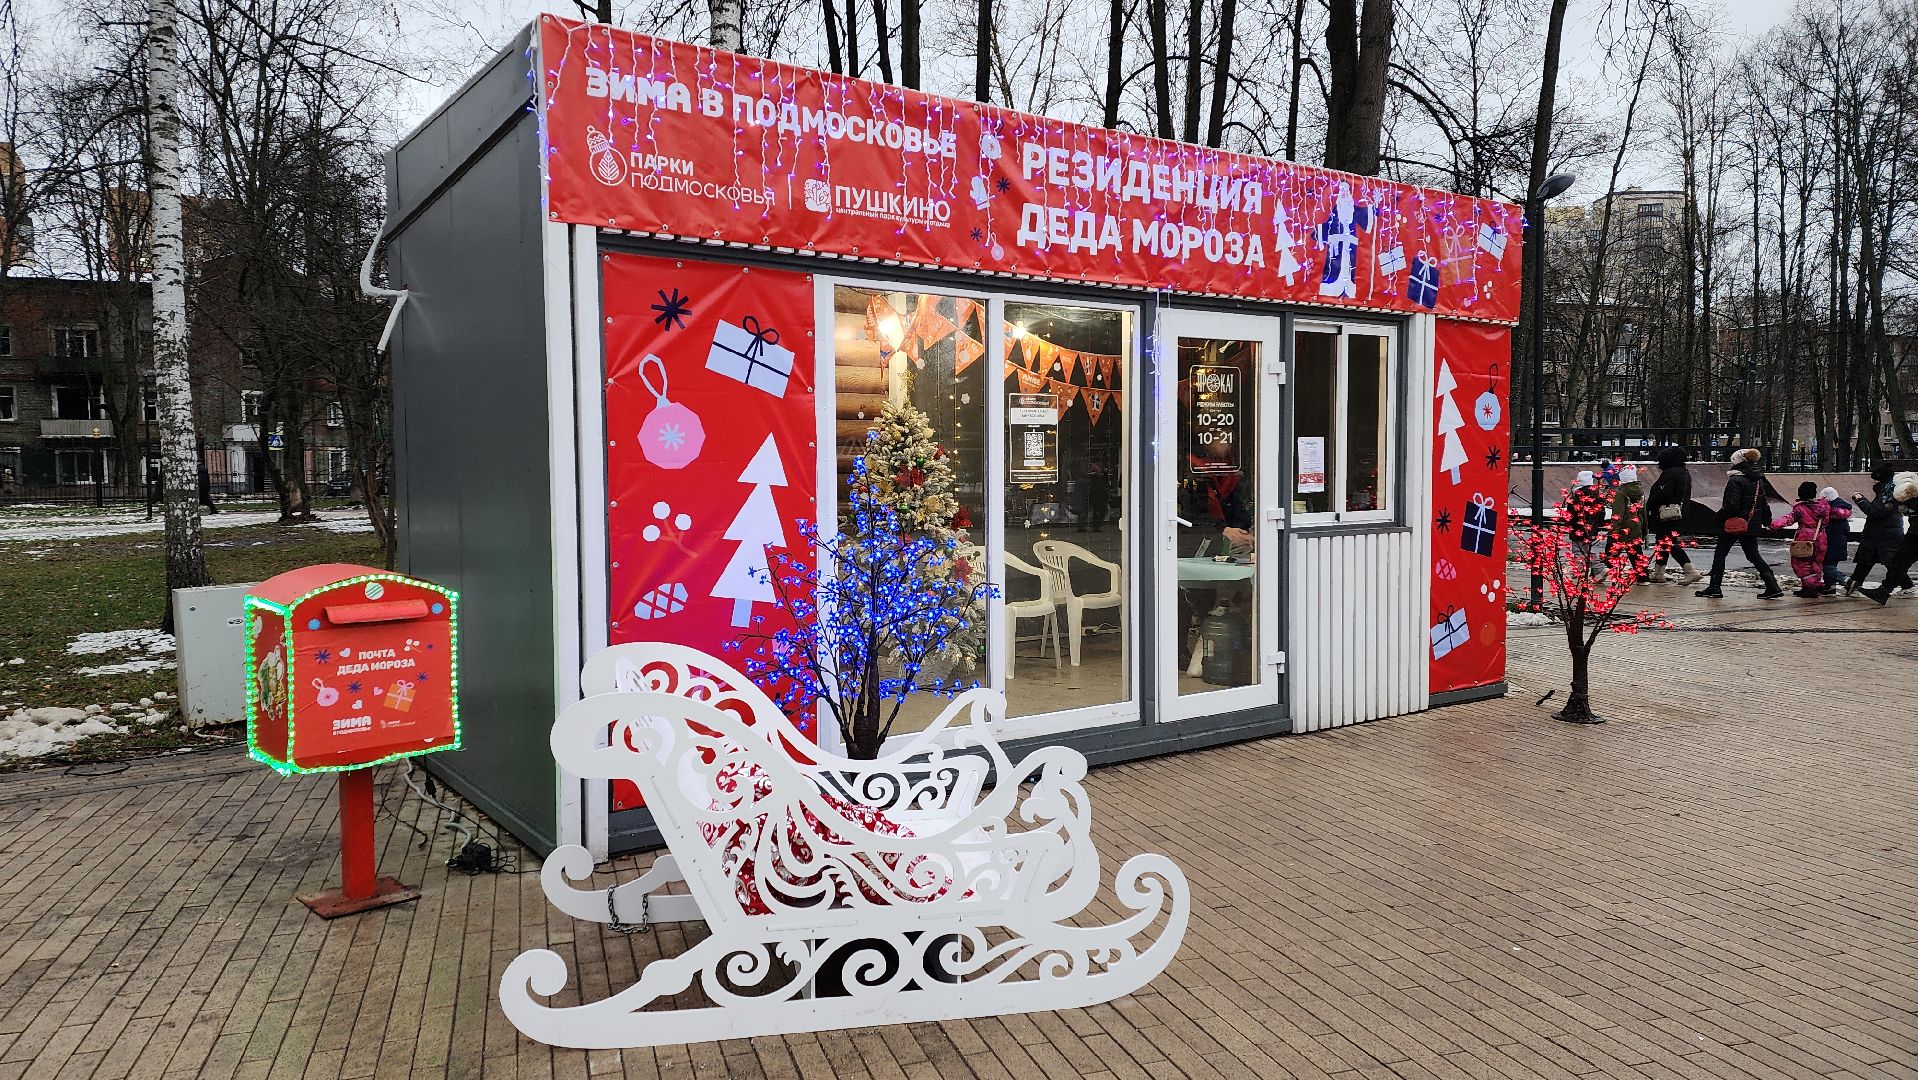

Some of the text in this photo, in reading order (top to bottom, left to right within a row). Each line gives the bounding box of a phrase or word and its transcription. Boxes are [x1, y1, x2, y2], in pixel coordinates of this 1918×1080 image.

[585, 67, 957, 159] ЗИМА В ПОДМОСКОВЬЕ
[630, 152, 694, 176] ПАРКИ
[631, 172, 775, 206] ПОДМОСКОВЬЯ
[1022, 142, 1263, 215] РЕЗИДЕНЦИЯ
[835, 185, 951, 221] ПУШКИНО
[835, 207, 879, 218] центральный
[1016, 202, 1265, 269] ДЕДА МОРОЗА
[1196, 413, 1234, 426] 10-20
[1197, 432, 1233, 444] 10-21
[358, 649, 396, 660] ПОЧТА
[336, 658, 416, 677] ДЕДА МОРОЗА
[332, 715, 372, 731] ЗИМА
